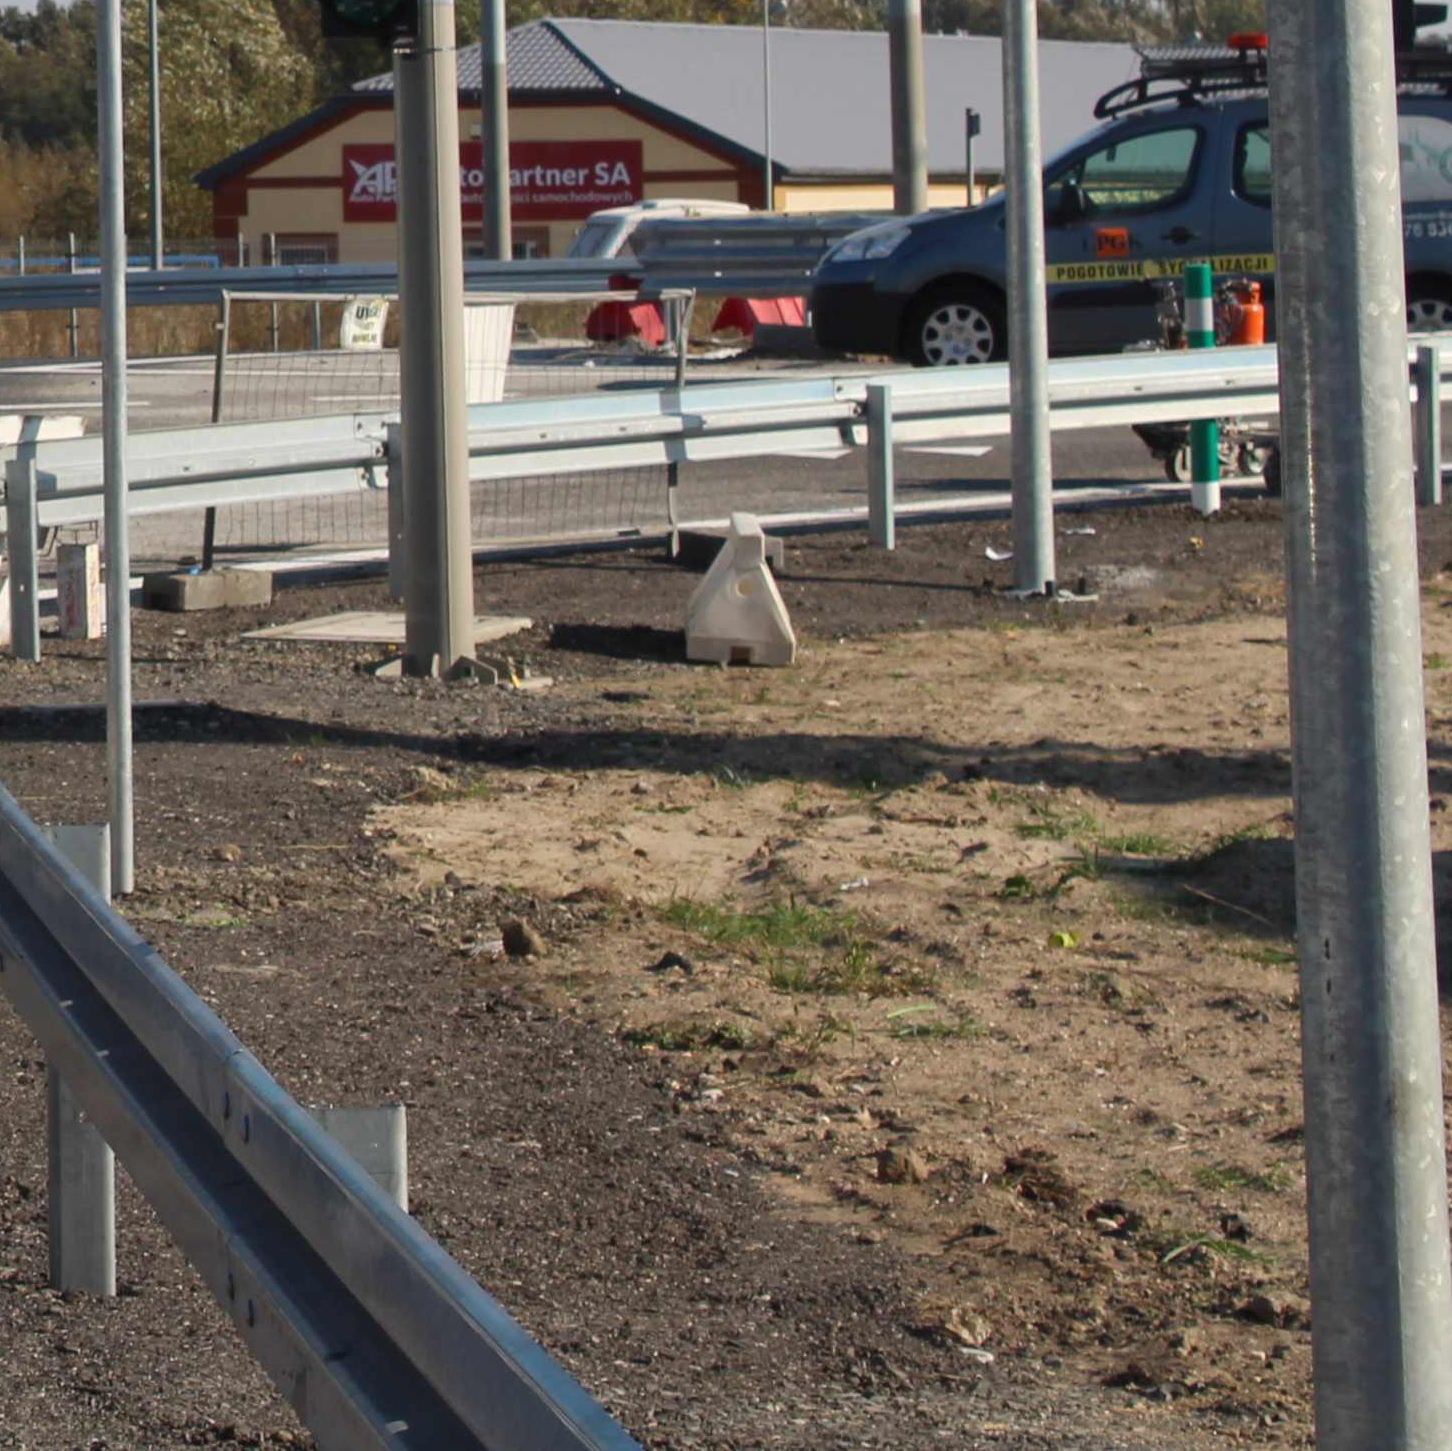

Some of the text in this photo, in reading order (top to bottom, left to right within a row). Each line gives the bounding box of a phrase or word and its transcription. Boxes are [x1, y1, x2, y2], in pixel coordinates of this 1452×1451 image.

[510, 165, 589, 186] artner
[594, 161, 631, 186] SA
[1056, 265, 1145, 280] POGOTOWIE
